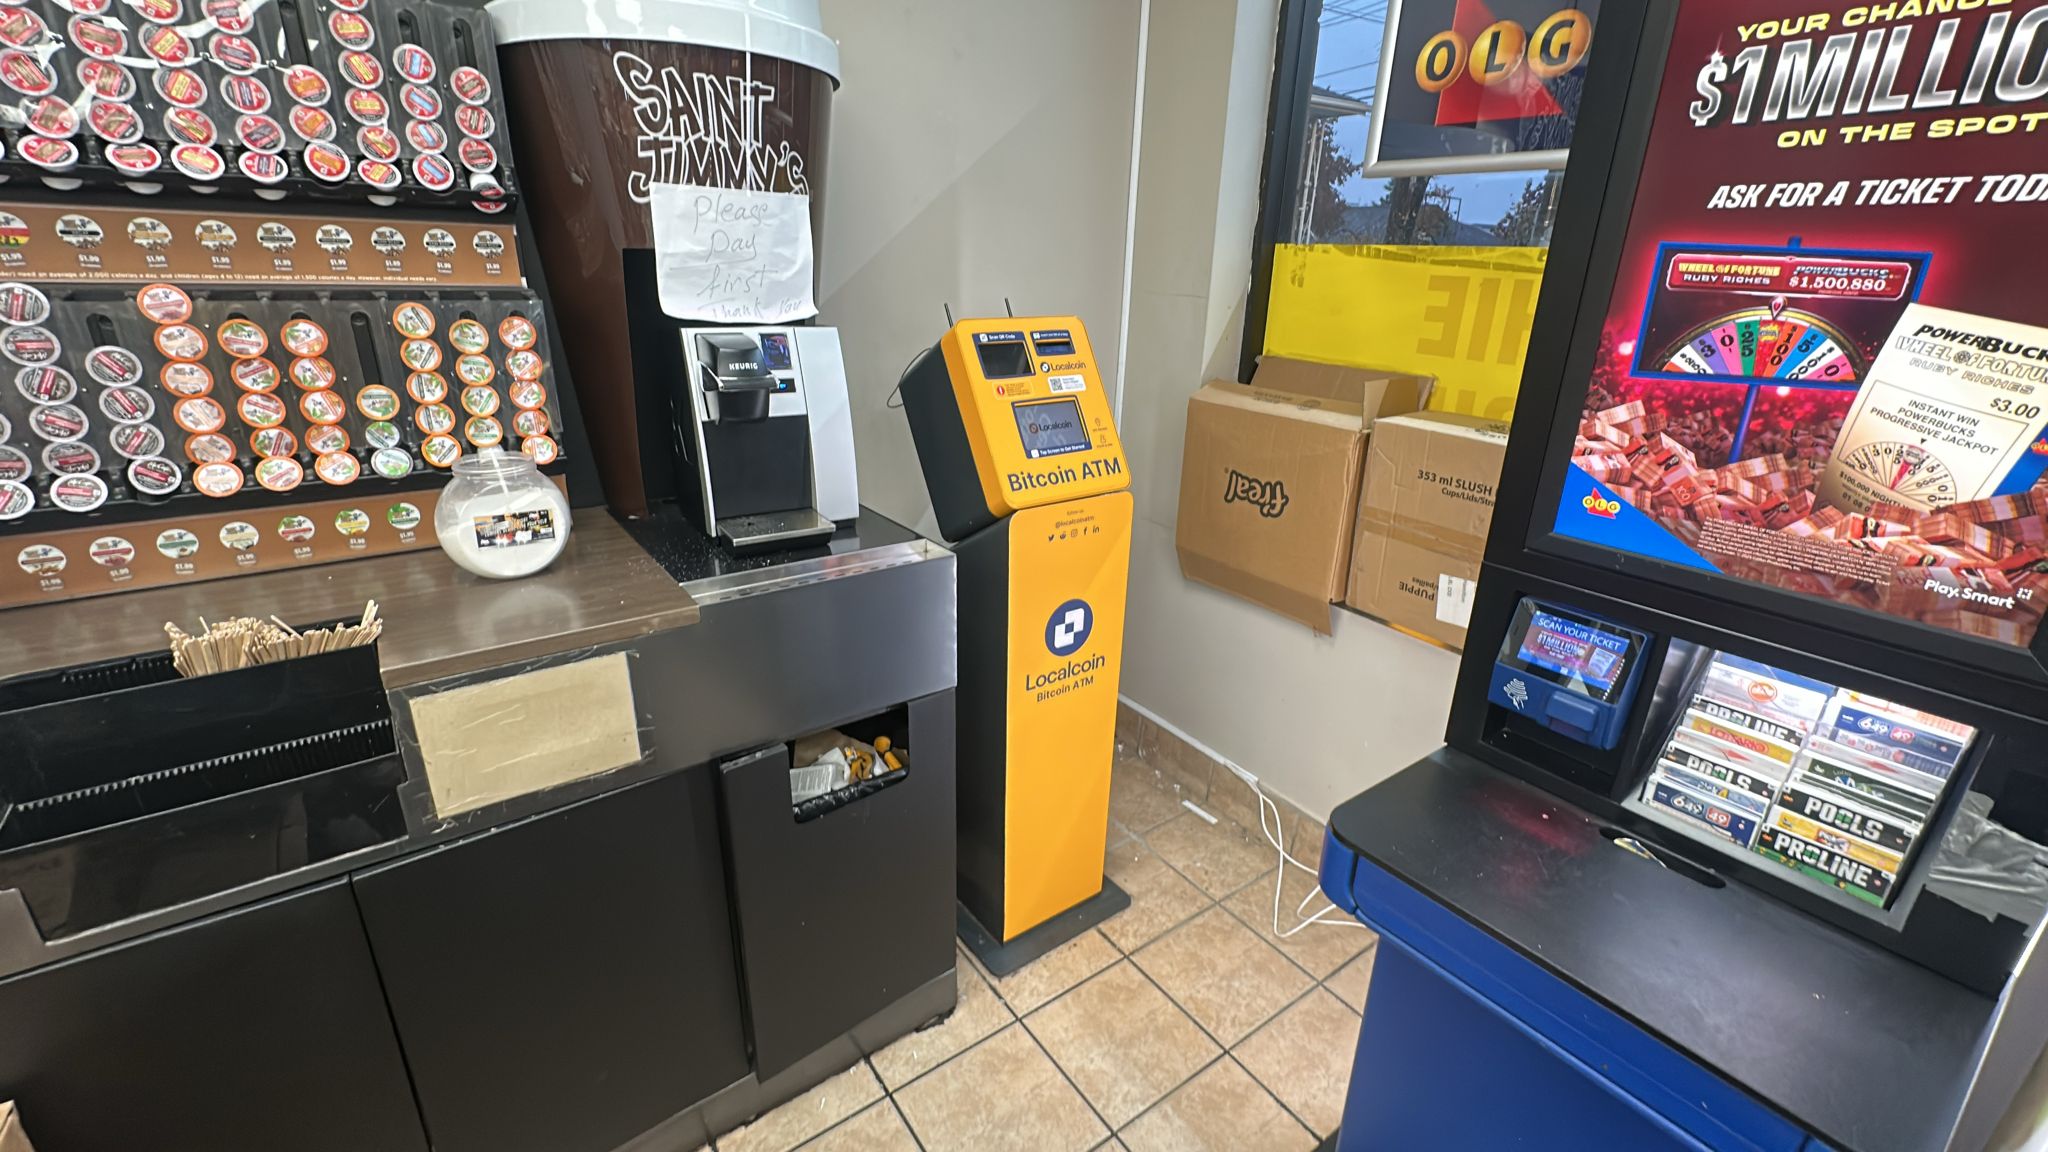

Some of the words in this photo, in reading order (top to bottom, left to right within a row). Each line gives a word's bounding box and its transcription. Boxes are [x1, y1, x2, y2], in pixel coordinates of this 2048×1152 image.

[1736, 12, 1830, 42] YOUR
[1424, 18, 1577, 84] OLG
[613, 51, 775, 151] SAINT
[1777, 129, 1827, 148] ON
[1840, 122, 1916, 144] THE
[1927, 112, 2048, 139] SPOT
[628, 136, 809, 203] JIMMY'S
[1707, 184, 1769, 210] ASK
[1765, 181, 1825, 207] FOR
[1823, 181, 1850, 206] A
[1855, 176, 1974, 206] TICKET
[1975, 173, 2048, 203] TOD
[1678, 262, 1715, 275] WHEEL
[1730, 264, 1781, 277] FORTUNE
[1793, 265, 1891, 279] POWERBUCKS
[1684, 273, 1718, 283] RUBY
[1723, 275, 1771, 285] RICHES
[1789, 276, 1887, 292] $1,500,880
[1895, 335, 1953, 362] WHEEL
[1050, 361, 1087, 372] Localcoin
[1909, 357, 1958, 376] RUBY
[1961, 370, 2035, 395] RICHES
[1898, 407, 1976, 438] POWERBUCKS
[1908, 400, 1955, 420] INSTANT
[1956, 414, 1981, 428] WIN
[1990, 398, 2041, 419] $3.00
[1039, 421, 1072, 432] Localcoin
[1870, 406, 1943, 438] PROGRESSIVE
[1941, 434, 1999, 456] JACKPOT
[1007, 466, 1077, 493] Bitcoin
[1082, 457, 1122, 479] ATM
[1417, 469, 1437, 482] 353
[1439, 476, 1453, 486] ml
[1455, 479, 1493, 497] SLUSH
[1839, 471, 1870, 494] $100,000
[1585, 498, 1619, 512] OLG
[1398, 581, 1435, 601] PUPPIE
[1538, 617, 1563, 632] SCAN
[1563, 625, 1589, 641] YOUR
[1589, 634, 1622, 651] TICKET
[1025, 653, 1106, 692] Localcoin
[1036, 683, 1070, 703] Bitcoin
[1073, 676, 1094, 693] ATM
[1803, 796, 1884, 841] POOLS
[1773, 832, 1873, 888] PROLINE
